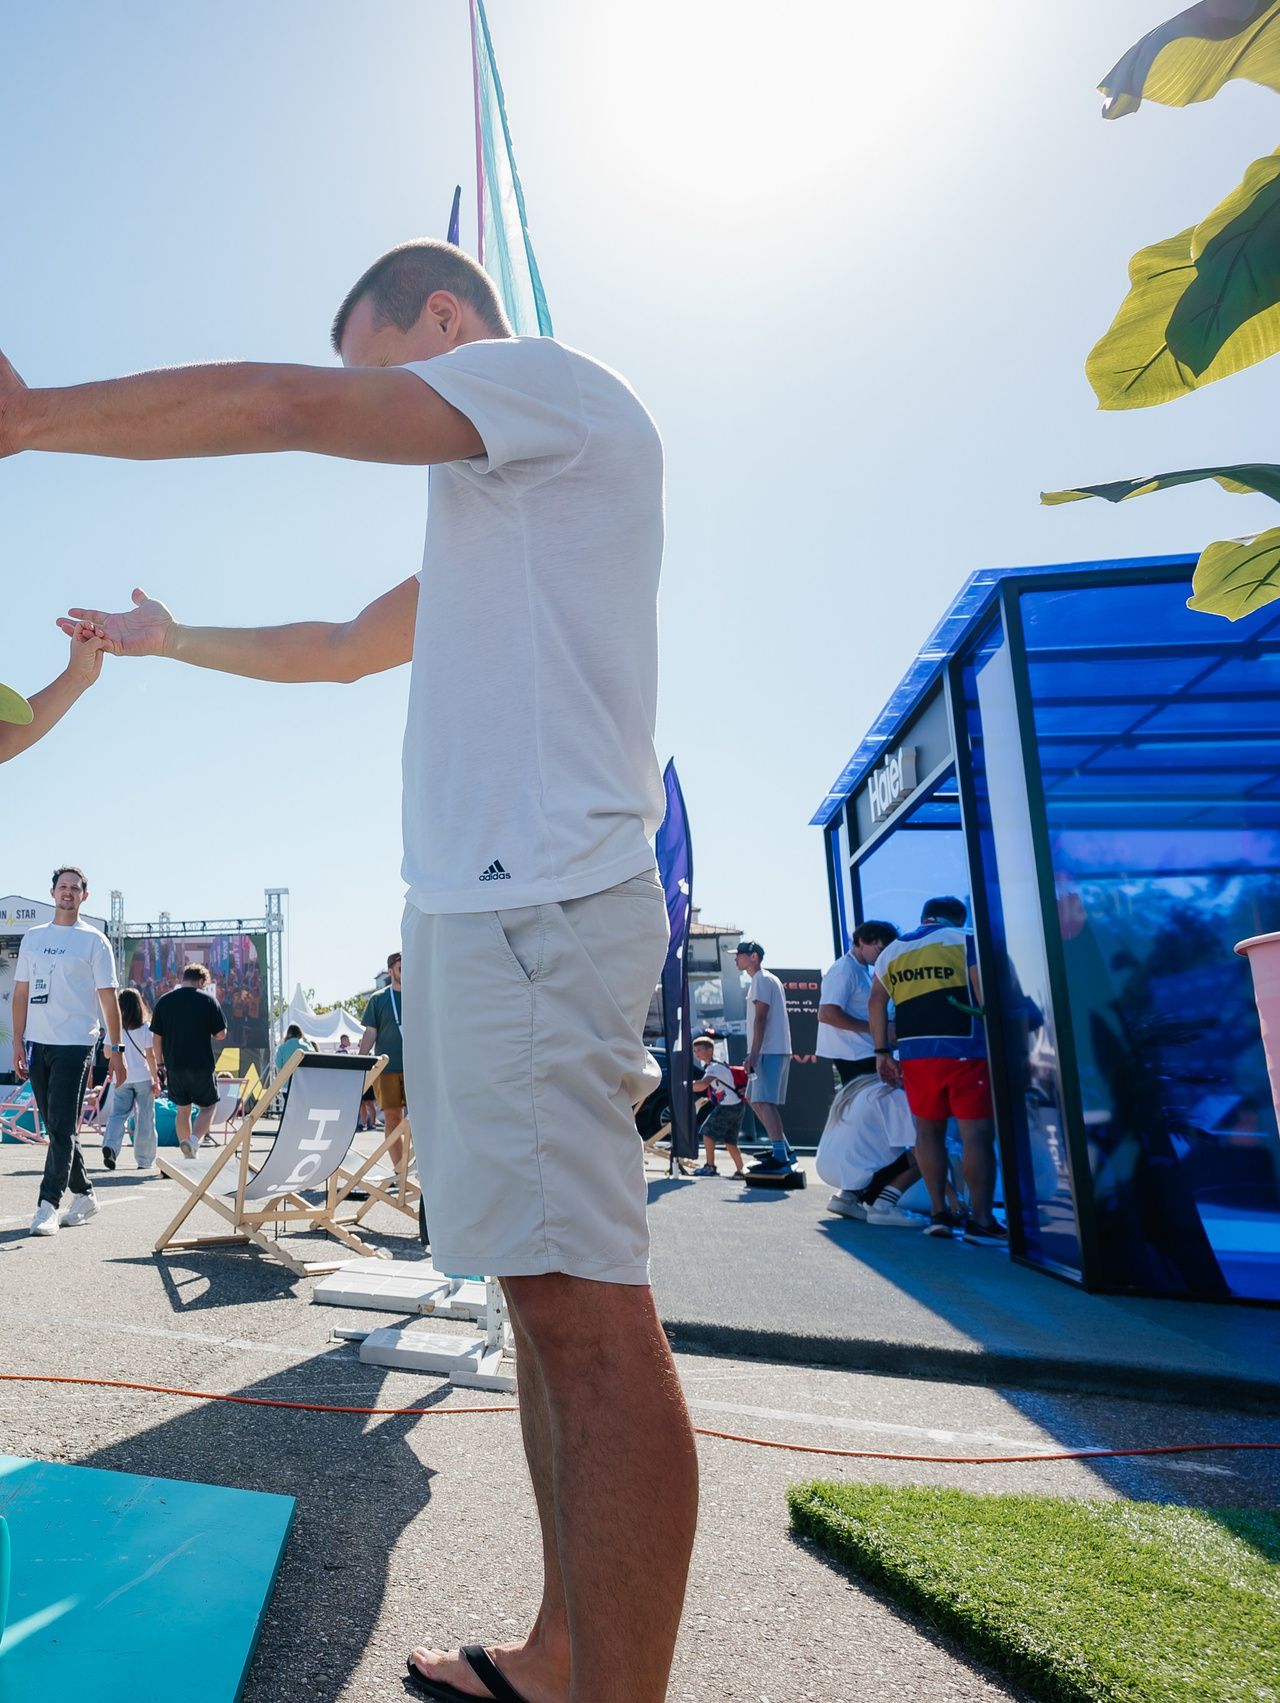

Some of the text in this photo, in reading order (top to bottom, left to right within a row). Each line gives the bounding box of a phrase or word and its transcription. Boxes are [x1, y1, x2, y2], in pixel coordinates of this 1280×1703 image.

[868, 747, 907, 823] Haier
[478, 872, 511, 881] adidas
[16, 909, 36, 920] STAR
